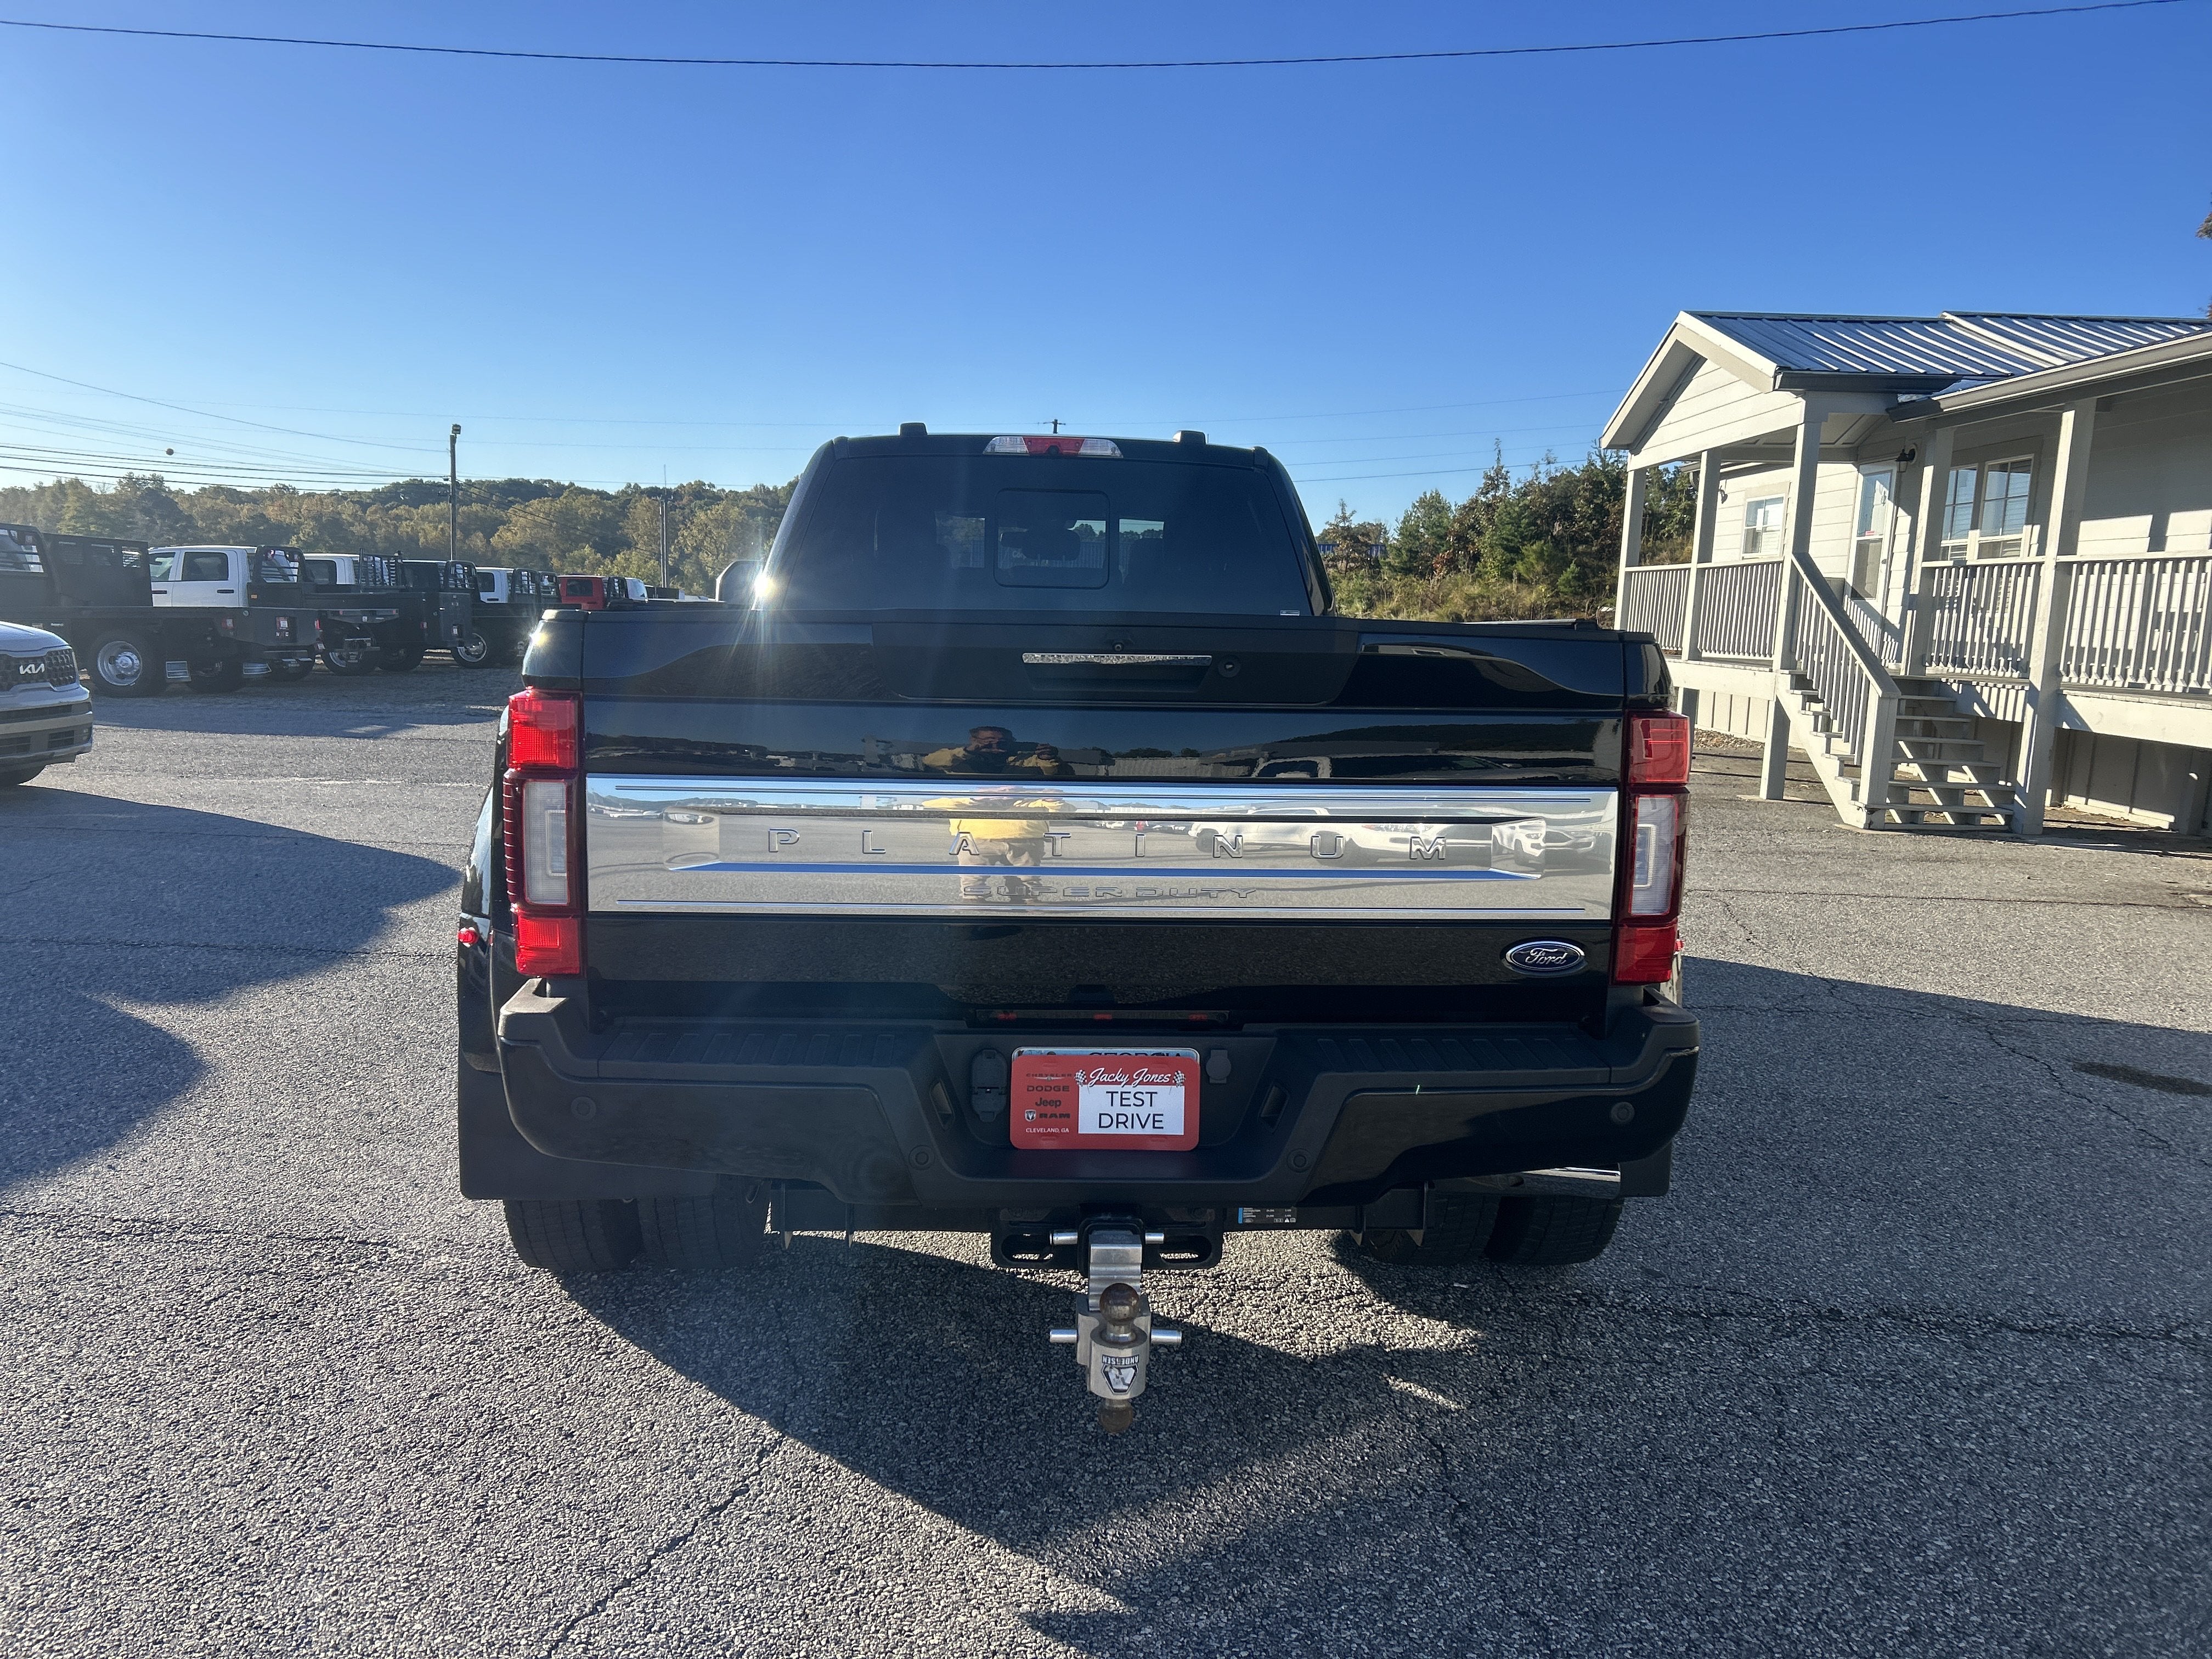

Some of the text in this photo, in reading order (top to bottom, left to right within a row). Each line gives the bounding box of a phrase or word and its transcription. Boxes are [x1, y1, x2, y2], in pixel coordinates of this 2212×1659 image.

[20, 663, 45, 674] KIA
[768, 828, 1446, 860] PLATINUM
[963, 886, 1256, 899] SUPER DUTY
[1525, 947, 1568, 964] Ford
[1088, 1067, 1171, 1088] Jacky Jones
[1035, 1097, 1062, 1108] Jeep
[1106, 1091, 1158, 1107] TEST
[1098, 1113, 1164, 1130] DRIVE
